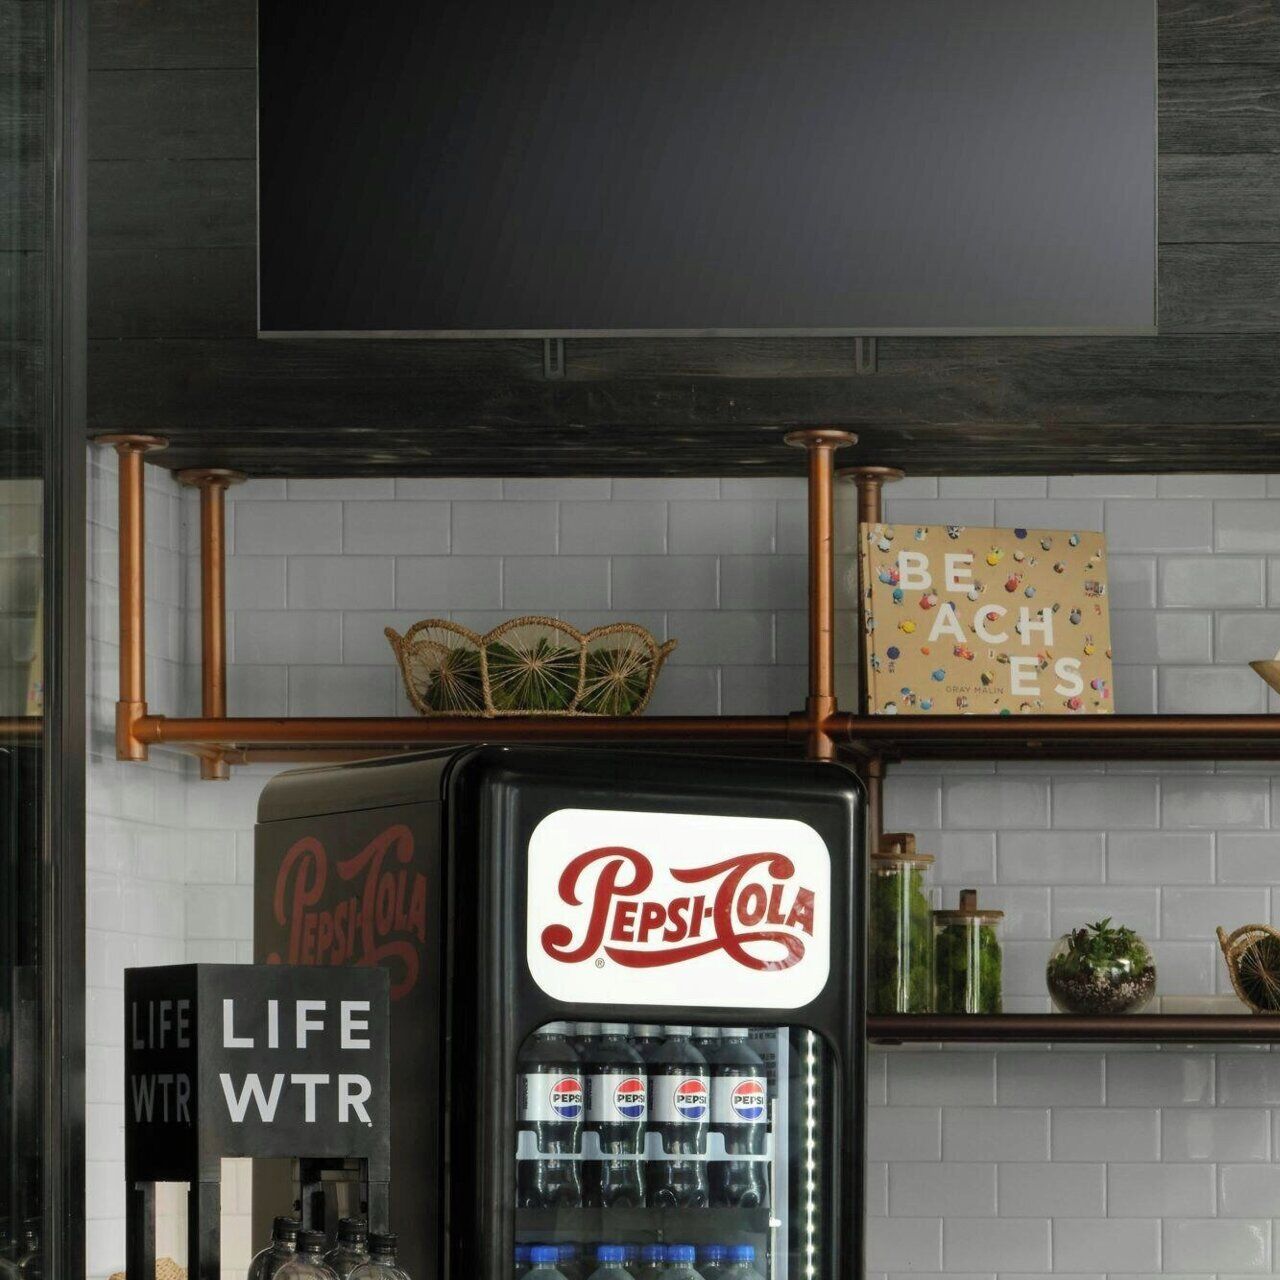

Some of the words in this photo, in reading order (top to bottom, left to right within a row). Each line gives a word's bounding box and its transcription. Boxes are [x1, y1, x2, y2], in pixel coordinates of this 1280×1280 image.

[897, 550, 974, 592] BE
[928, 603, 1054, 646] ACH
[974, 686, 1005, 694] MALIN
[1010, 656, 1084, 697] ES
[132, 999, 190, 1049] LIFE
[223, 999, 371, 1049] LIFE
[132, 1073, 191, 1124] WTR
[219, 1073, 373, 1124] WTR
[677, 1093, 707, 1104] PEPSI
[734, 1095, 764, 1105] PEPSI
